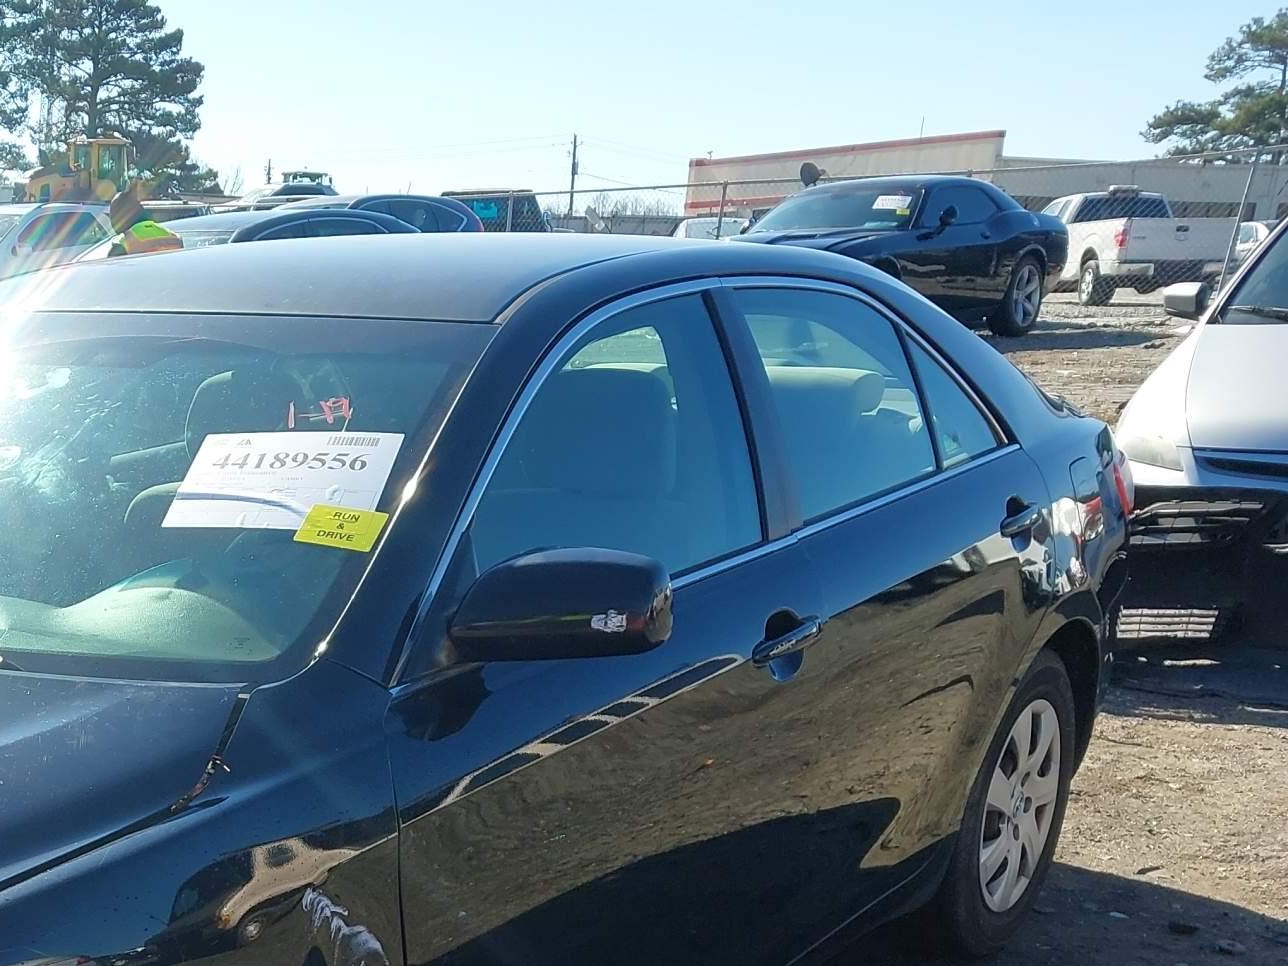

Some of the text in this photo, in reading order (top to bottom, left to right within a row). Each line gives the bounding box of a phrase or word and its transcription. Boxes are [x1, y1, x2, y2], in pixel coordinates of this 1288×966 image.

[212, 451, 371, 471] 44189556
[333, 510, 361, 522] RUN
[336, 521, 345, 530] &
[316, 529, 355, 542] DRIVE
